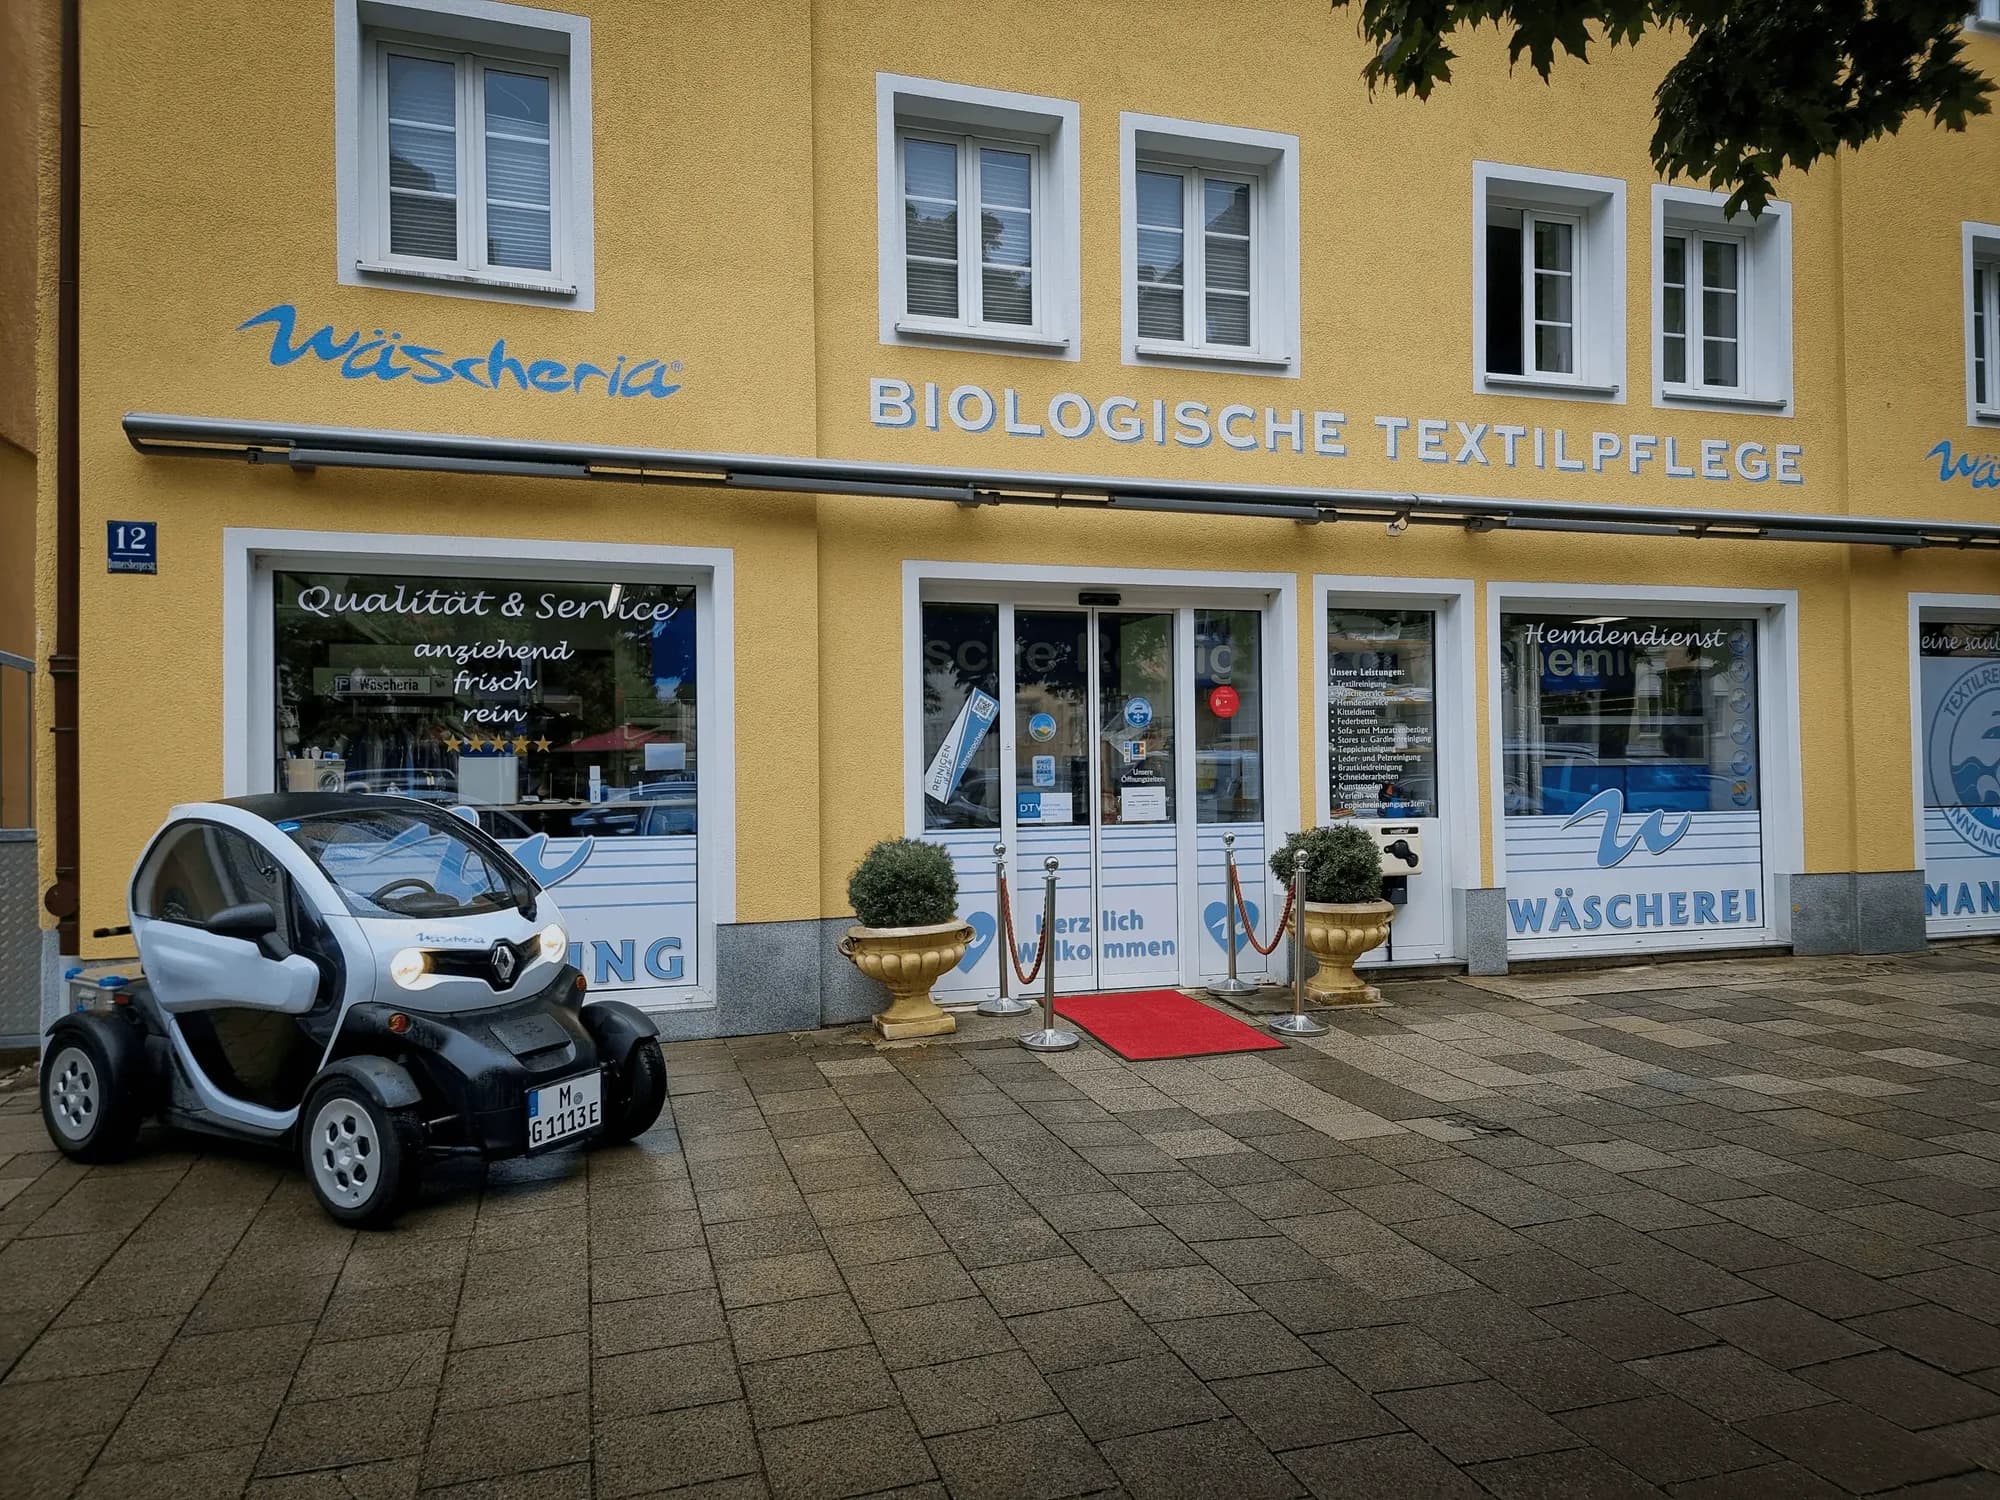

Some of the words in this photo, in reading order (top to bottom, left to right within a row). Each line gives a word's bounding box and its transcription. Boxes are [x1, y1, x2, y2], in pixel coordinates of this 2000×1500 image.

[869, 377, 1347, 457] BIOLOGISCHE
[1374, 416, 1805, 486] TEXTILPFLEGE
[1924, 440, 2000, 489] Wä
[116, 526, 147, 549] 12
[298, 585, 496, 618] Qualität
[501, 592, 525, 617] &
[536, 593, 678, 621] Service
[1524, 622, 1728, 649] Hemdendienst
[1921, 632, 1961, 650] eine
[414, 639, 574, 665] anziehend
[453, 669, 538, 695] frisch
[1330, 668, 1358, 677] Unsere
[1360, 668, 1405, 678] Leistungen:
[463, 705, 528, 723] rein
[1337, 708, 1376, 716] Kitteldienst
[932, 744, 952, 792] REINIGEN
[1507, 887, 1757, 934] WÄSCHEREI
[1924, 881, 2000, 915] MAN
[560, 1085, 571, 1109] M
